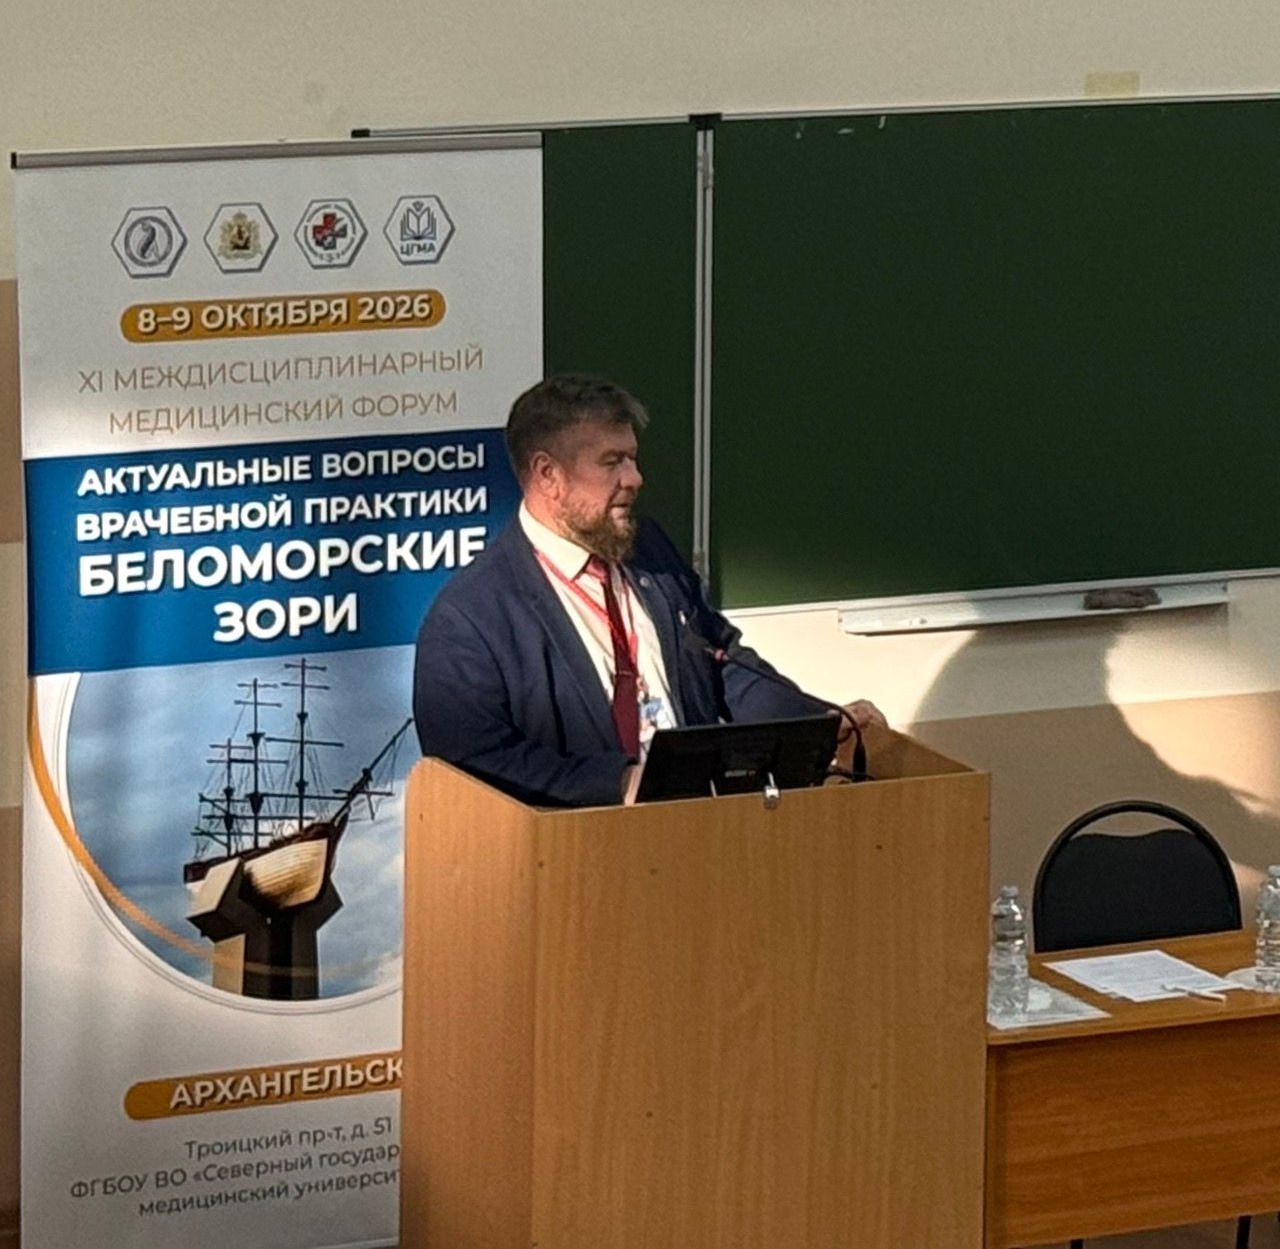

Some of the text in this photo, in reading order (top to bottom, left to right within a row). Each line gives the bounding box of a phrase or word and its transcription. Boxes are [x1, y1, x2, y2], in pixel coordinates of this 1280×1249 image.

[201, 297, 349, 330] ОКТЯБРЯ
[357, 294, 431, 321] 2026
[78, 343, 484, 394] XI МЕЖДИСЦИПЛИНАРНЫЙ
[109, 391, 458, 435] МЕДИЦИНСКИЙ ФОРУМ
[77, 443, 485, 497] АКТУАЛЬНЫЕ ВОПРОСЫ
[76, 486, 488, 541] ВРАЧЕБНОЙ ПРАКТИКИ
[79, 526, 487, 597] БЕЛОМОРСКИЕ
[213, 592, 358, 643] ЗОРИ
[169, 1057, 403, 1109] АРХАНГЕЛЬСК
[184, 1129, 292, 1162] Троицкий
[351, 1123, 369, 1142] д.
[373, 1116, 392, 1135] 51
[70, 1143, 401, 1198] ФГБОУ ВО «Северный государ
[139, 1180, 290, 1216] медицинский
